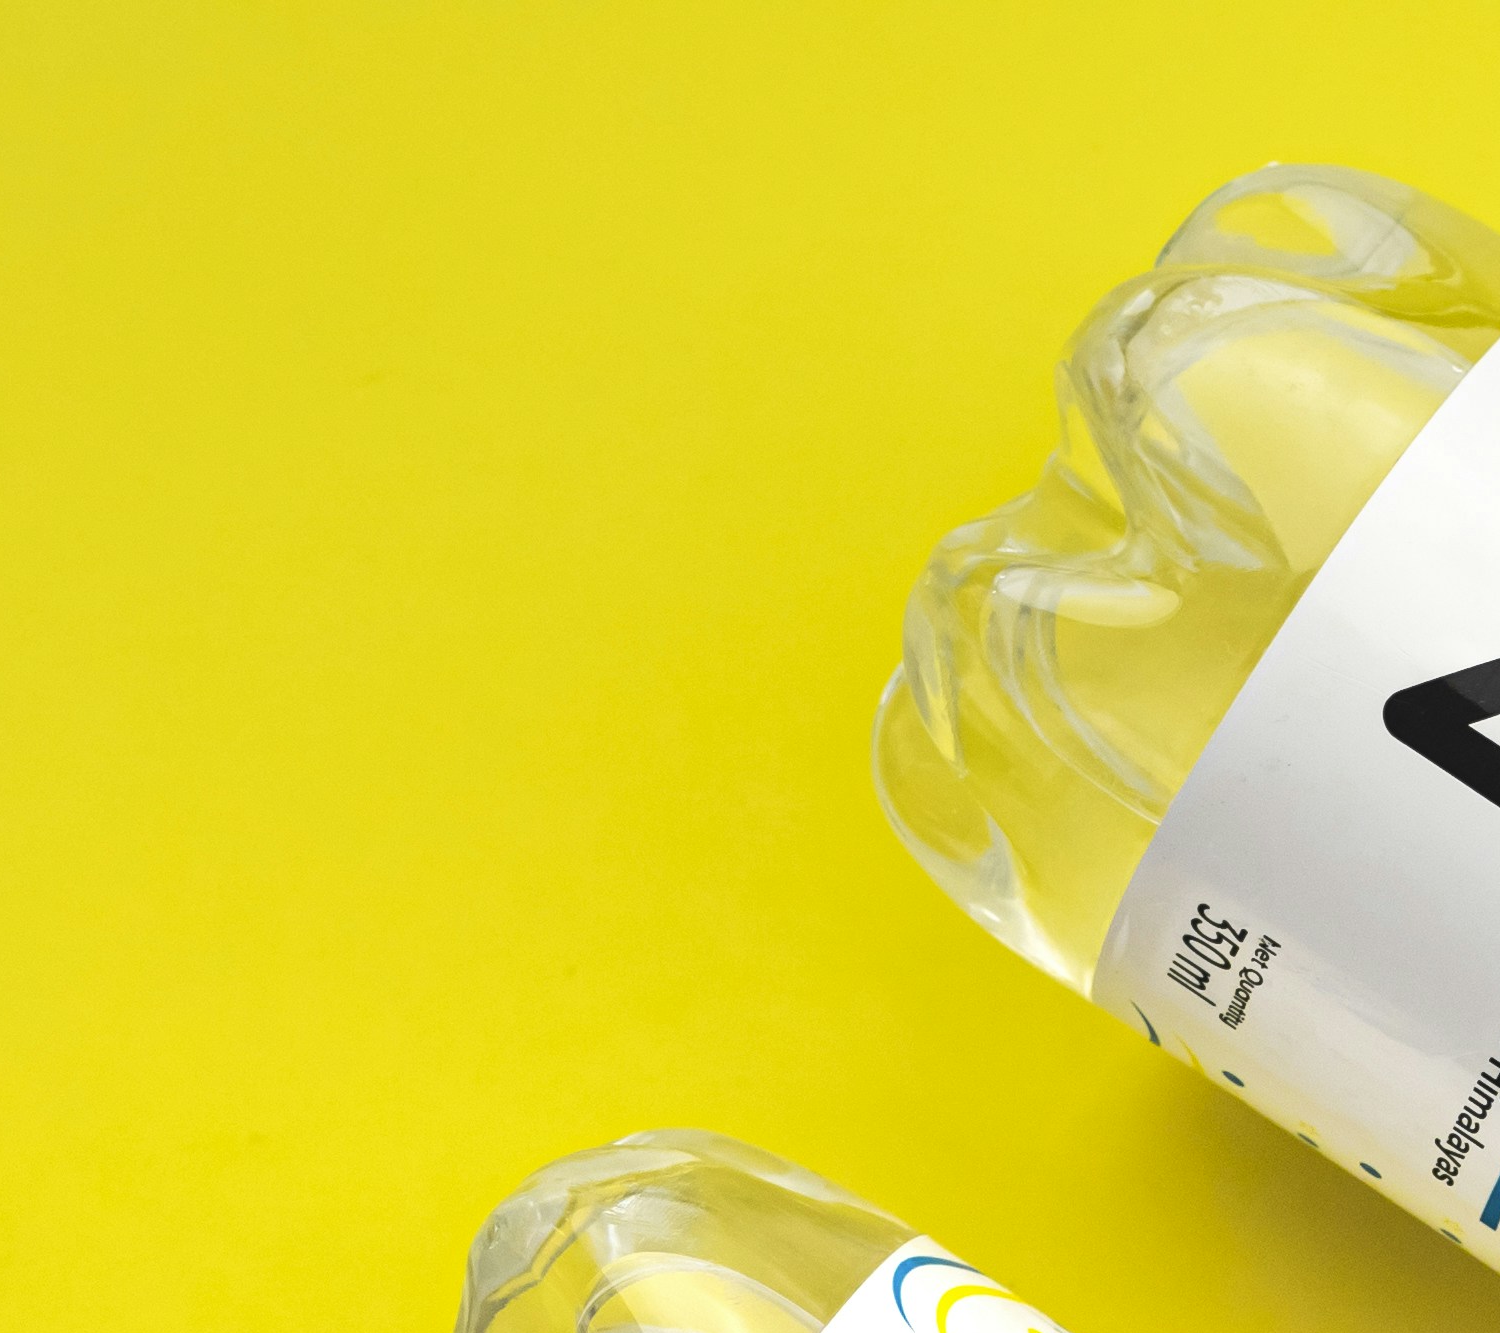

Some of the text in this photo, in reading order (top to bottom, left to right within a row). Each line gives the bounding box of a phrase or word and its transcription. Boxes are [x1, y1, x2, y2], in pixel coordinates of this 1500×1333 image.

[1165, 902, 1250, 1008] 350 ml
[1217, 933, 1283, 1031] Net Quantity
